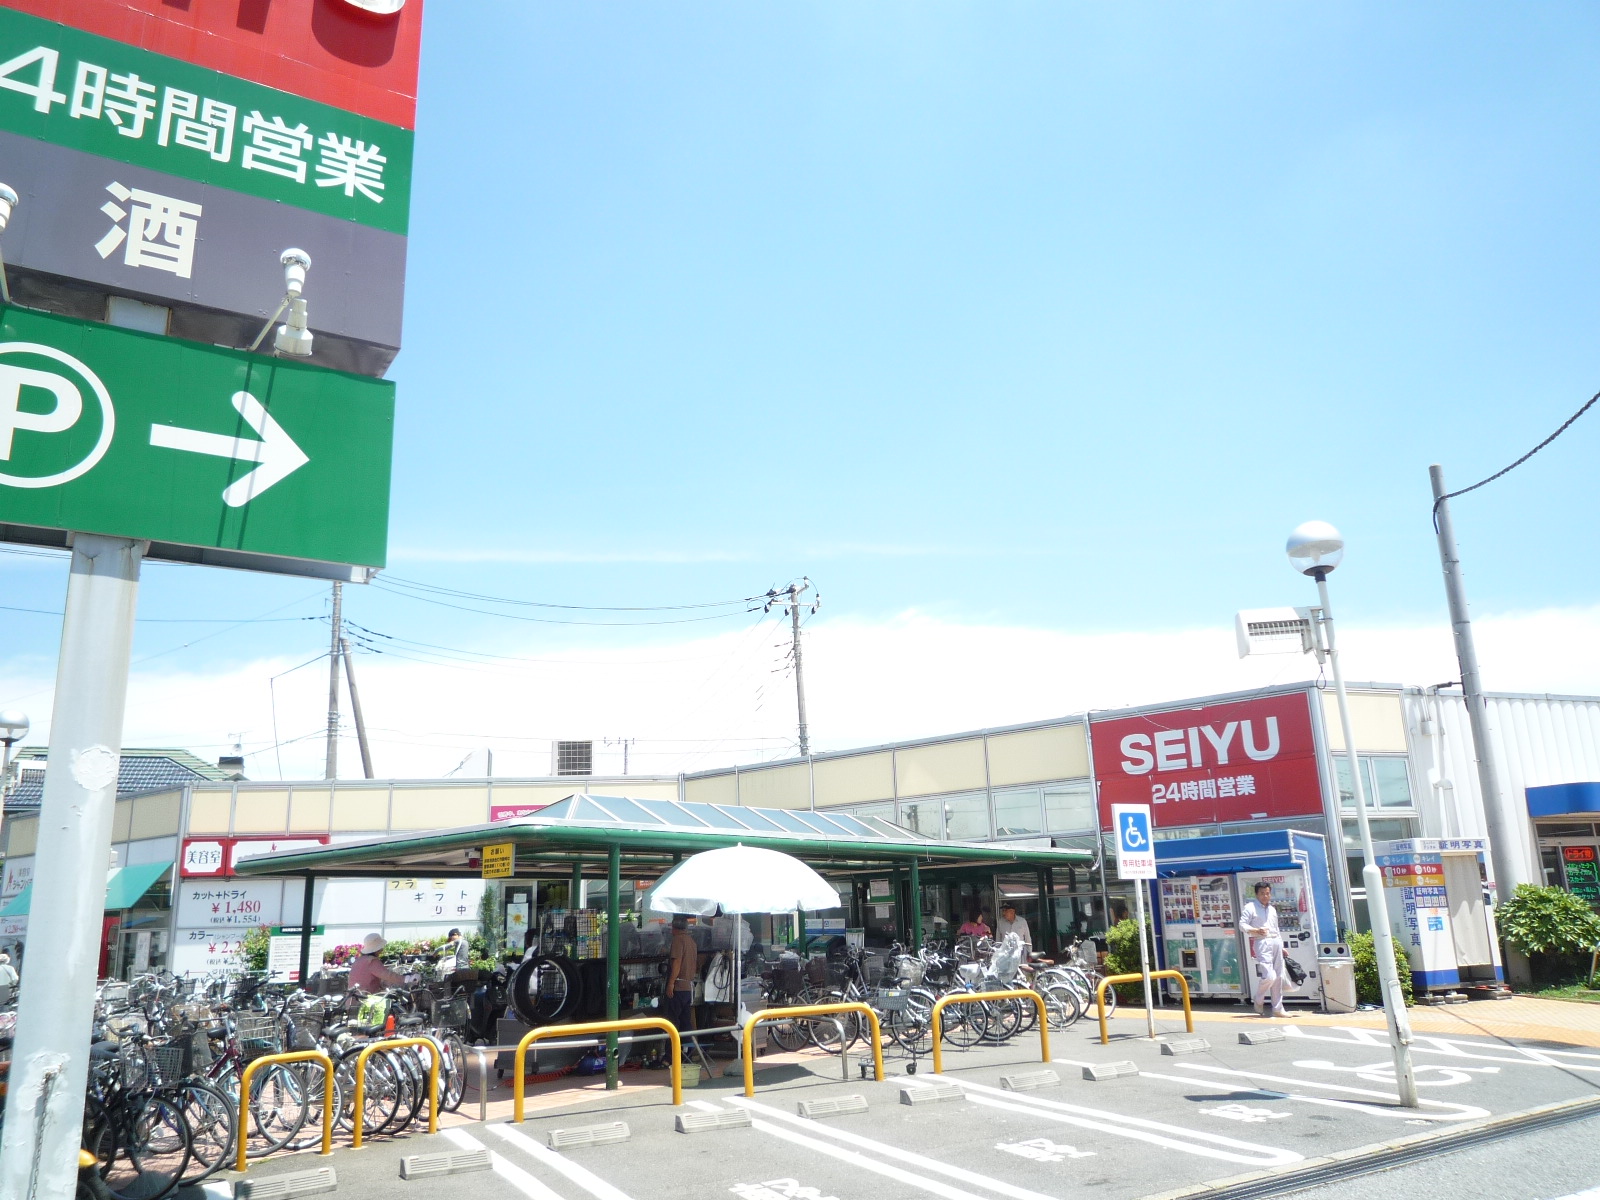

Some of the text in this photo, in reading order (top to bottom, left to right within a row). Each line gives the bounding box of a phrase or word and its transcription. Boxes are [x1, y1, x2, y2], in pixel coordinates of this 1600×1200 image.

[0, 45, 387, 205] 4時間営業
[94, 180, 203, 279] 酒
[0, 366, 83, 462] P
[1119, 716, 1281, 776] SEIYU
[1152, 775, 1256, 804] 24時間営業
[187, 850, 221, 865] 美容室
[1439, 840, 1484, 850] 証明写真
[189, 930, 214, 940] カラー
[1404, 887, 1421, 946] 証明写真
